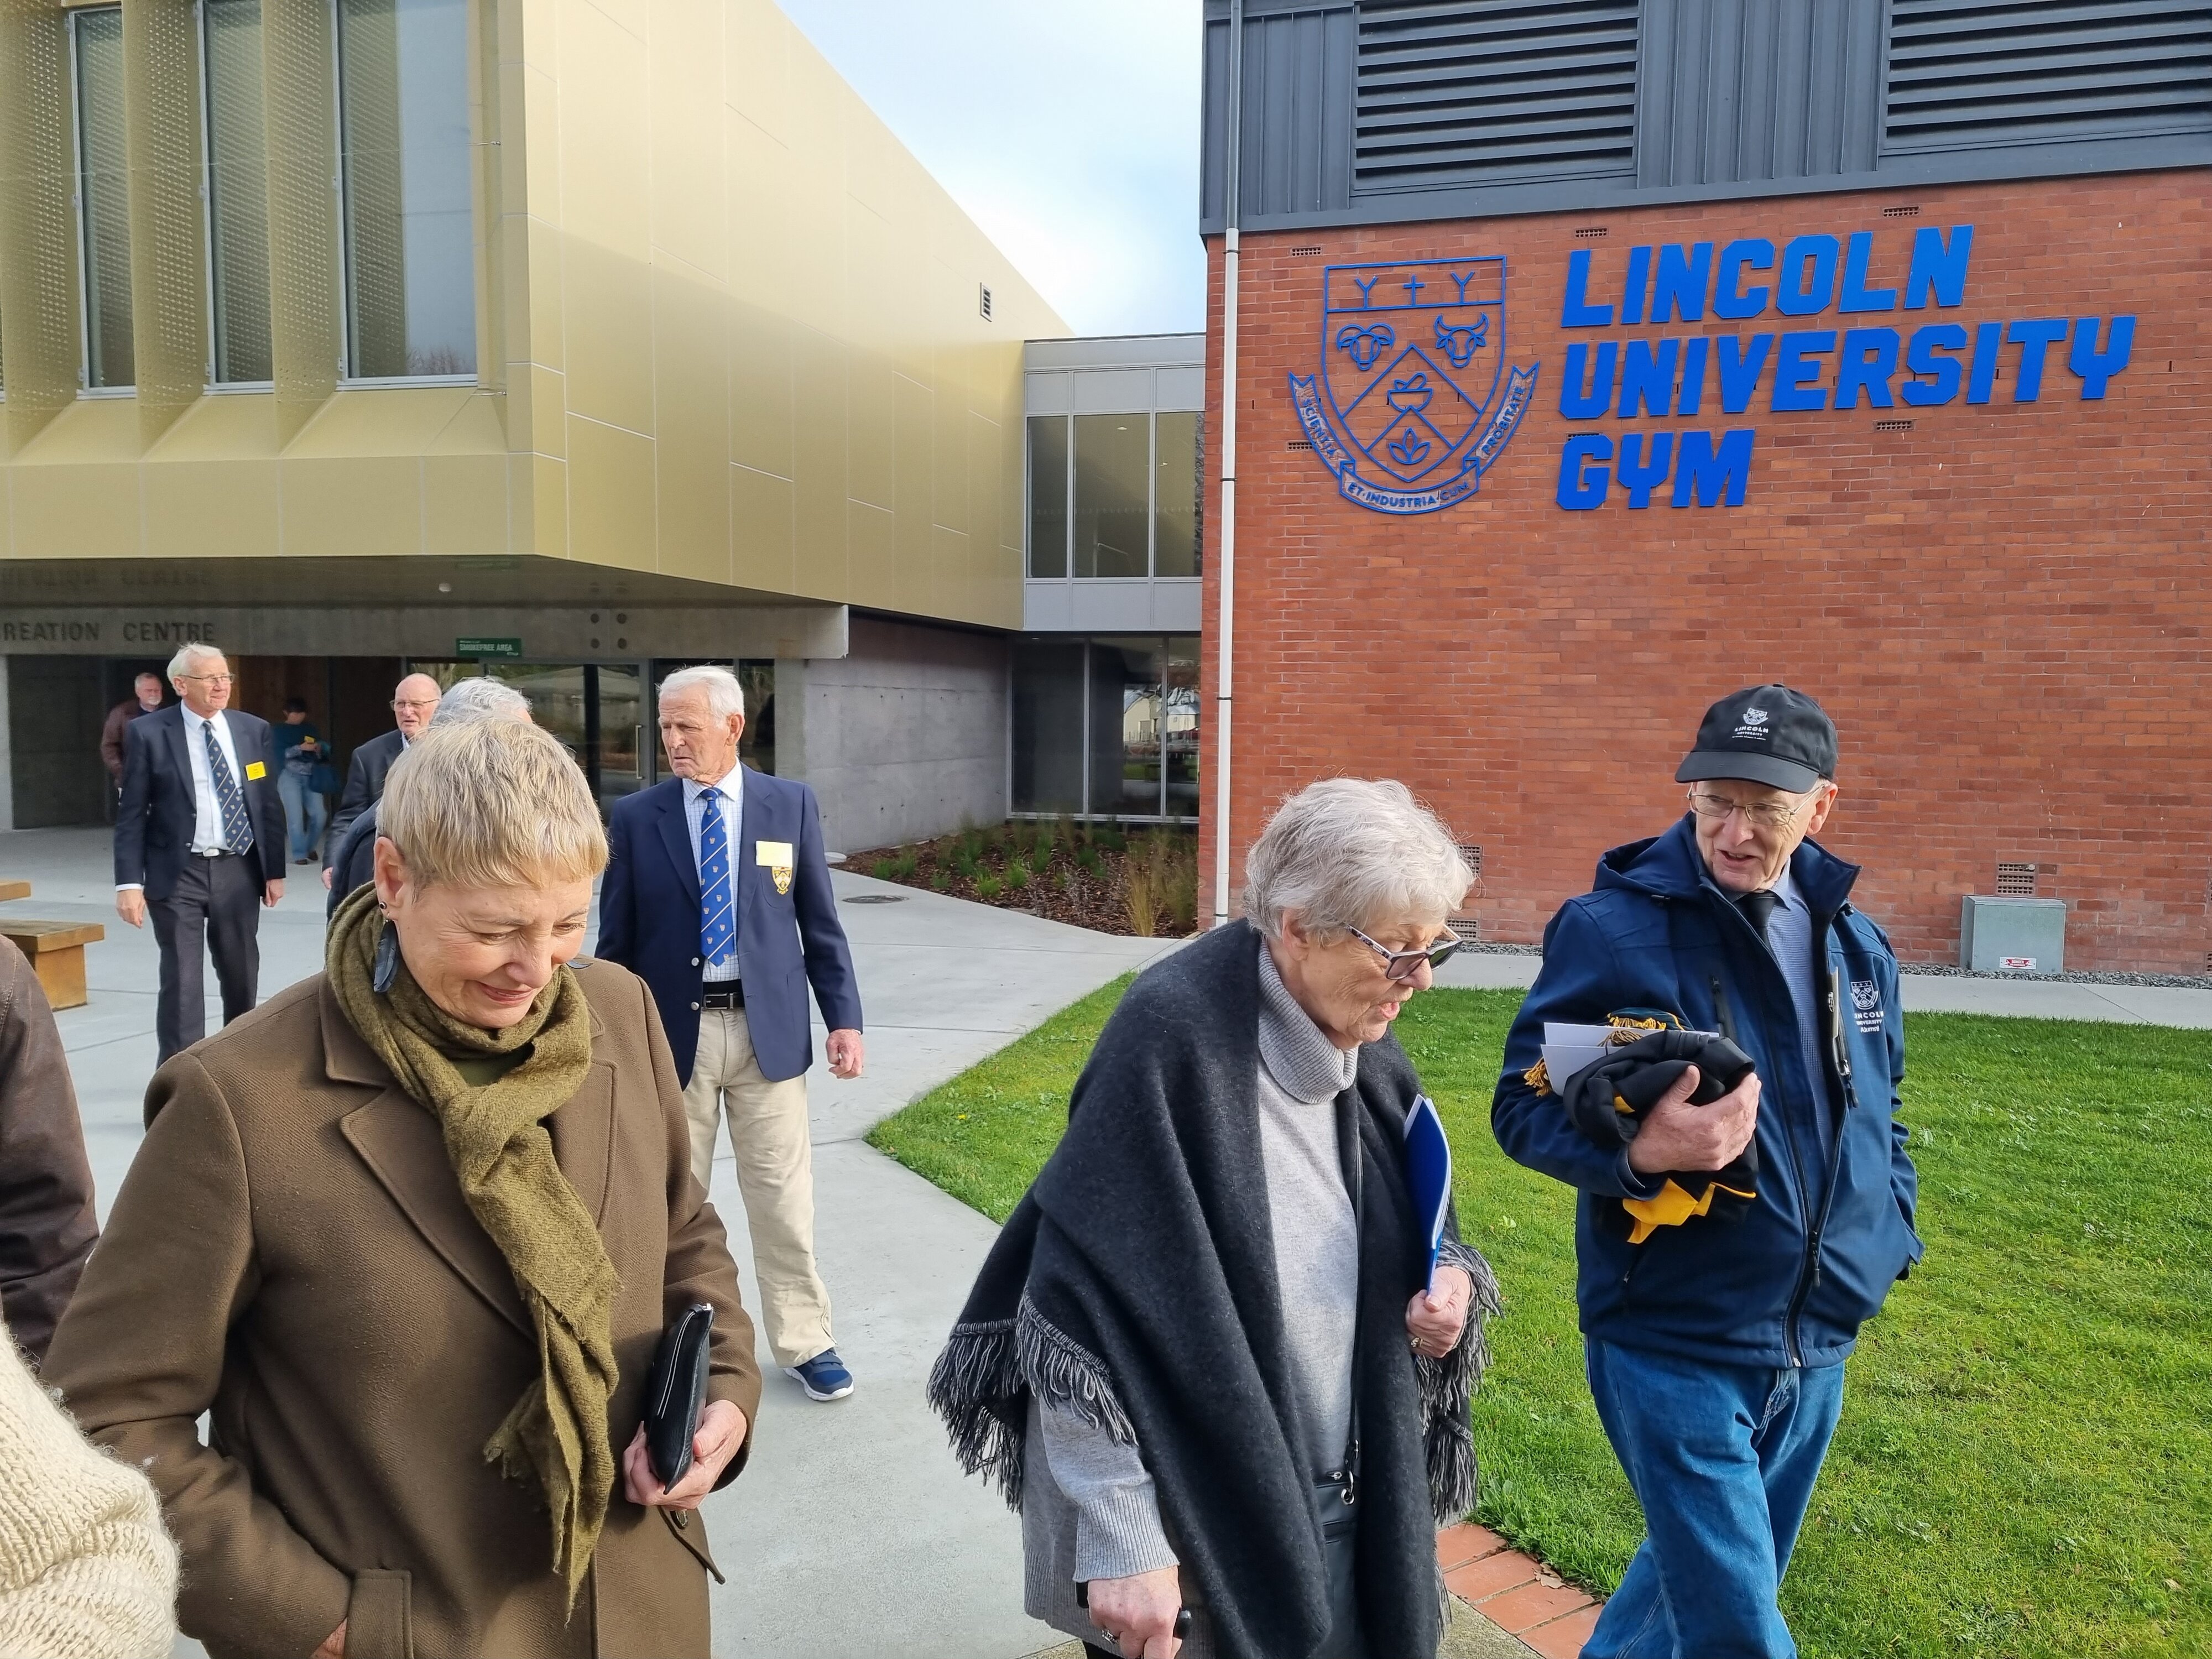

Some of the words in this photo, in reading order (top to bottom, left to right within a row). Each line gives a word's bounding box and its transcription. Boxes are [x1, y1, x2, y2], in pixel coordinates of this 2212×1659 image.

[1561, 224, 1974, 327] LINCOLN
[1559, 316, 2137, 420] UNIVERSITY
[1302, 398, 1335, 456] SCIENTIA
[1481, 386, 1525, 455] PROBITATE
[1555, 429, 1756, 510] GYM
[122, 622, 216, 642] CENTRE
